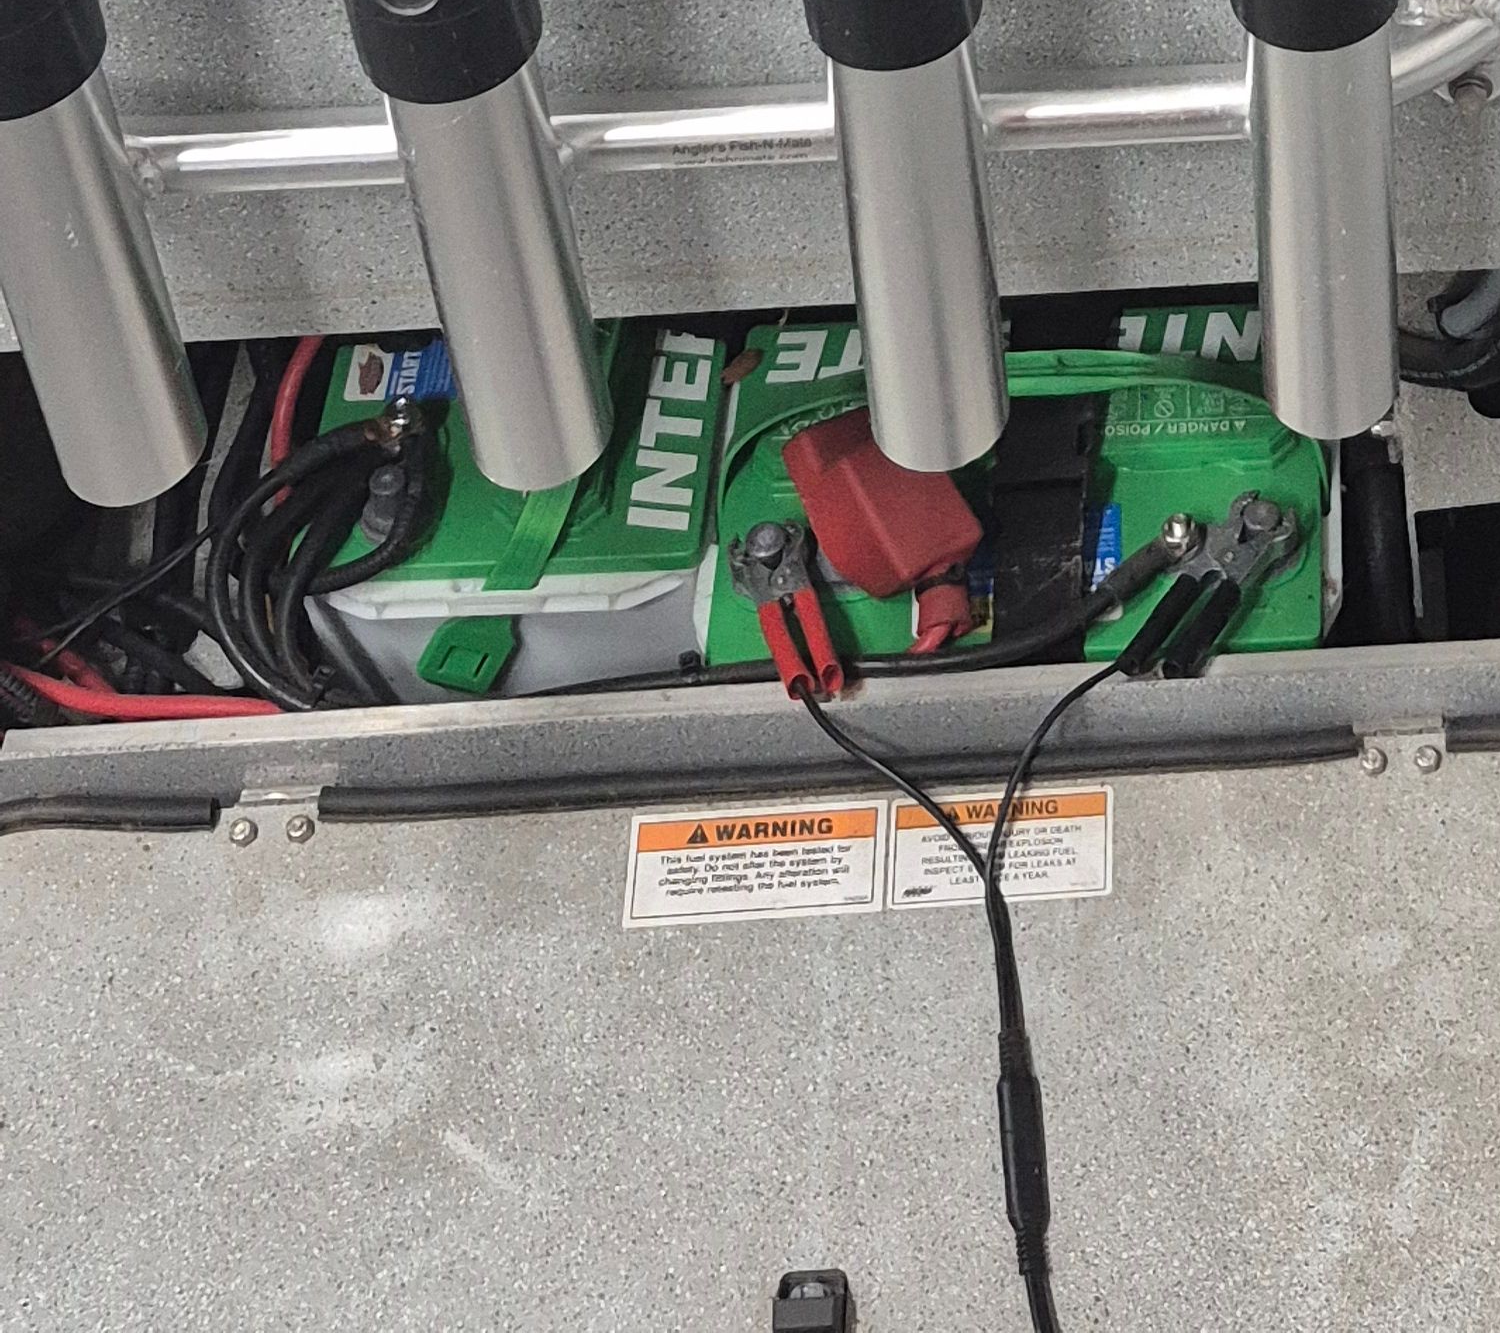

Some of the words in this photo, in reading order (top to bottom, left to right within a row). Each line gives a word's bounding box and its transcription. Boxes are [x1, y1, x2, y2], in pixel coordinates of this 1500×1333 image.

[1104, 423, 1151, 436] POISO
[1167, 420, 1230, 434] DANGER
[965, 798, 1059, 820] WANING
[715, 817, 834, 842] WARNING
[1050, 824, 1082, 835] DEATH
[921, 854, 968, 865] RESULTIN
